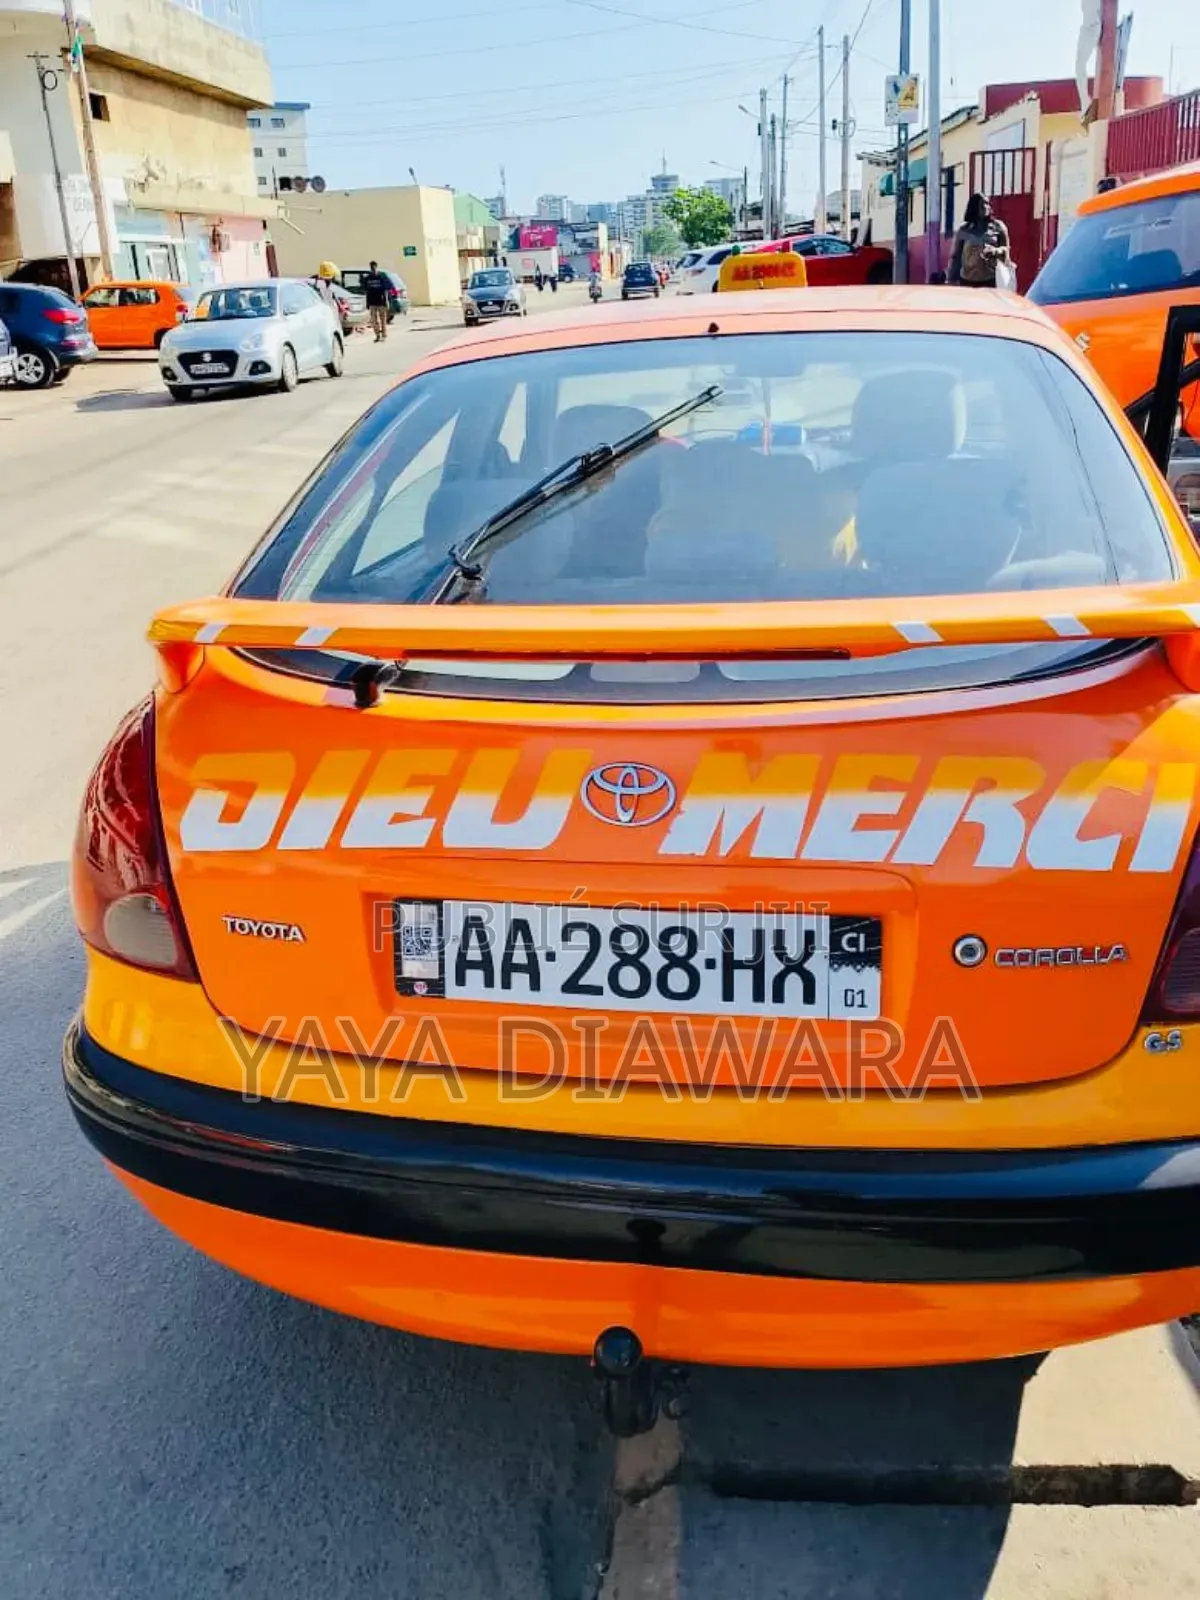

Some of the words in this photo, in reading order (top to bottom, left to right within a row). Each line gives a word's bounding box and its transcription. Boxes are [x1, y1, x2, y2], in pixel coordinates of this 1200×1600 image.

[180, 749, 593, 851] DIEU
[658, 752, 1199, 873] MERCI
[222, 916, 306, 943] TOYOTA
[840, 932, 866, 953] CI
[994, 943, 1128, 968] COROLLA
[843, 988, 869, 1009] 01
